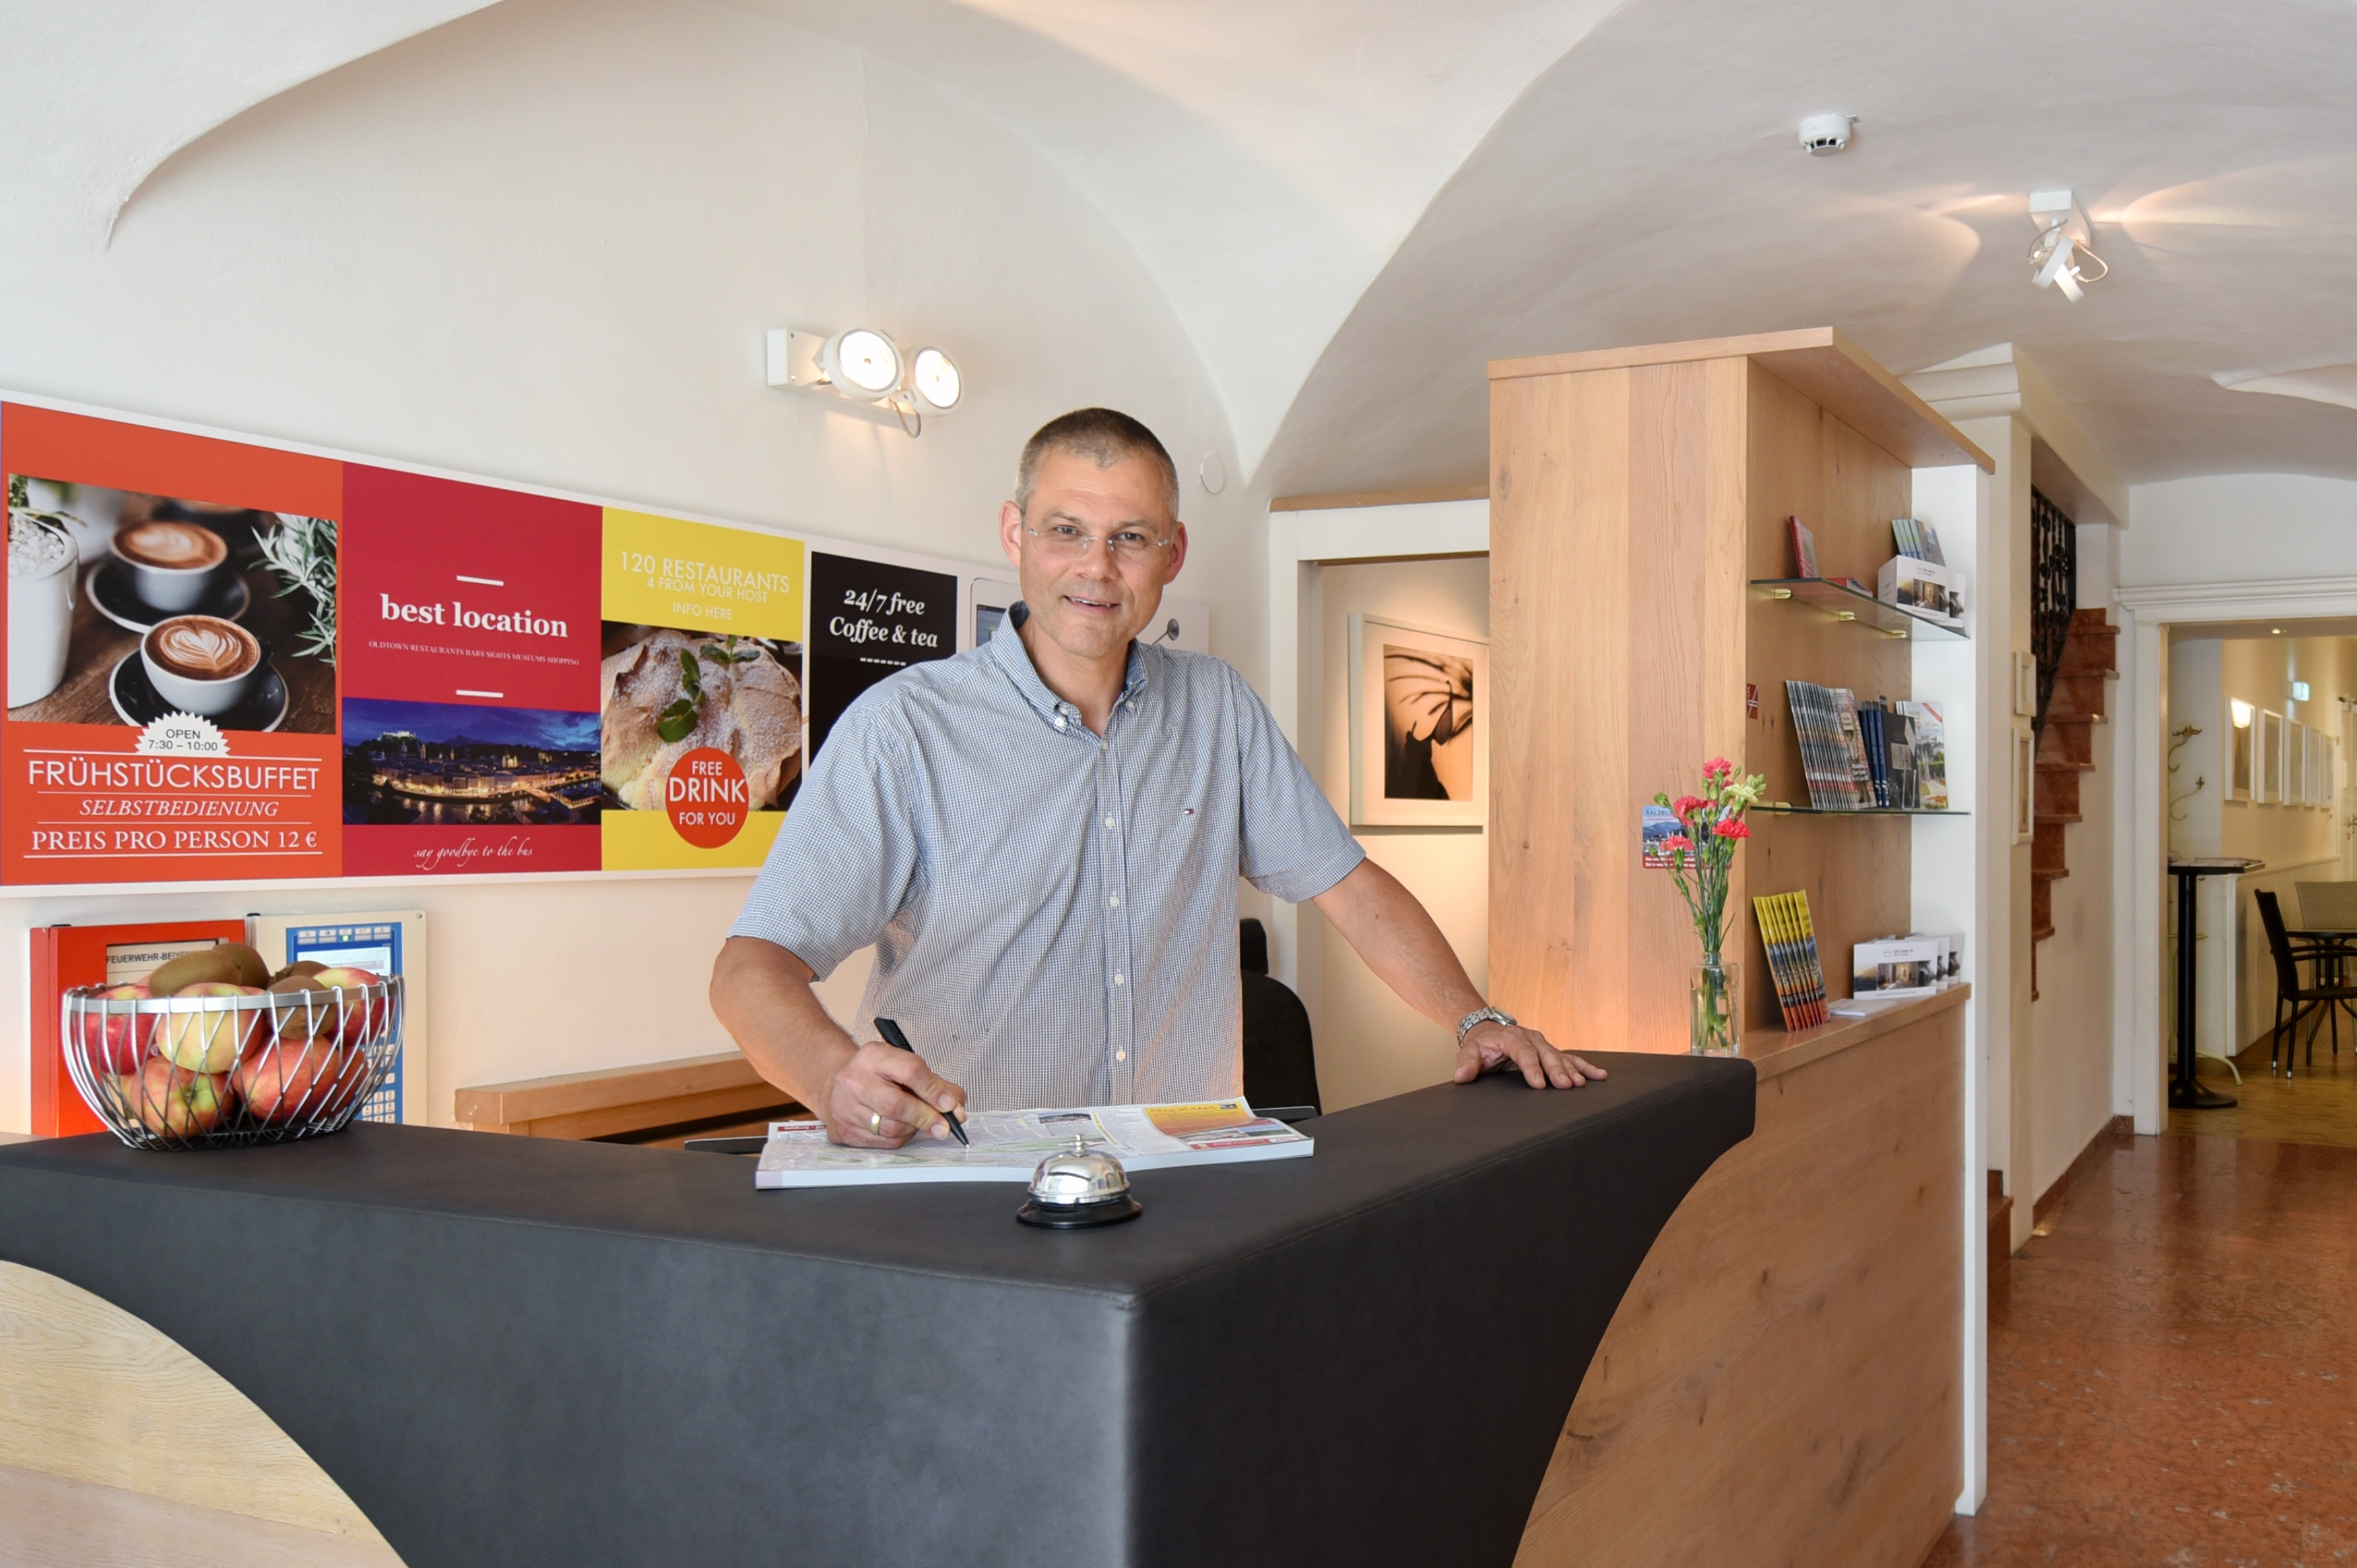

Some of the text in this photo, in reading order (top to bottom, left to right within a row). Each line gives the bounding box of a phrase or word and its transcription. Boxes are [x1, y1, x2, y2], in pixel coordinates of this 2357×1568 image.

[622, 551, 789, 593] 120 RESTAURANTS
[646, 577, 767, 603] 4 FROM YOUR HOST
[844, 588, 925, 615] 24/7 free
[380, 594, 568, 638] best location
[673, 602, 732, 620] INFO HERE
[830, 616, 938, 648] Coffee & tea
[368, 641, 579, 666] OLDTOWN RESTAURANTS BARS SIGHTS MUSEUMS SHOPPING
[147, 739, 173, 750] 7:30
[187, 741, 218, 751] 10:00
[166, 729, 201, 740] OPEN
[28, 757, 319, 790] FRÜHSTÜCKSBUFFET
[692, 761, 723, 776] FREE
[669, 777, 745, 803] DRINK
[79, 799, 279, 817] SELBSTBEDIENUNG
[679, 812, 735, 825] FOR YOU
[32, 831, 106, 850] PREIS
[114, 831, 166, 850] PRO
[174, 831, 270, 849] PERSON
[414, 836, 533, 871] say goodbye to the bus
